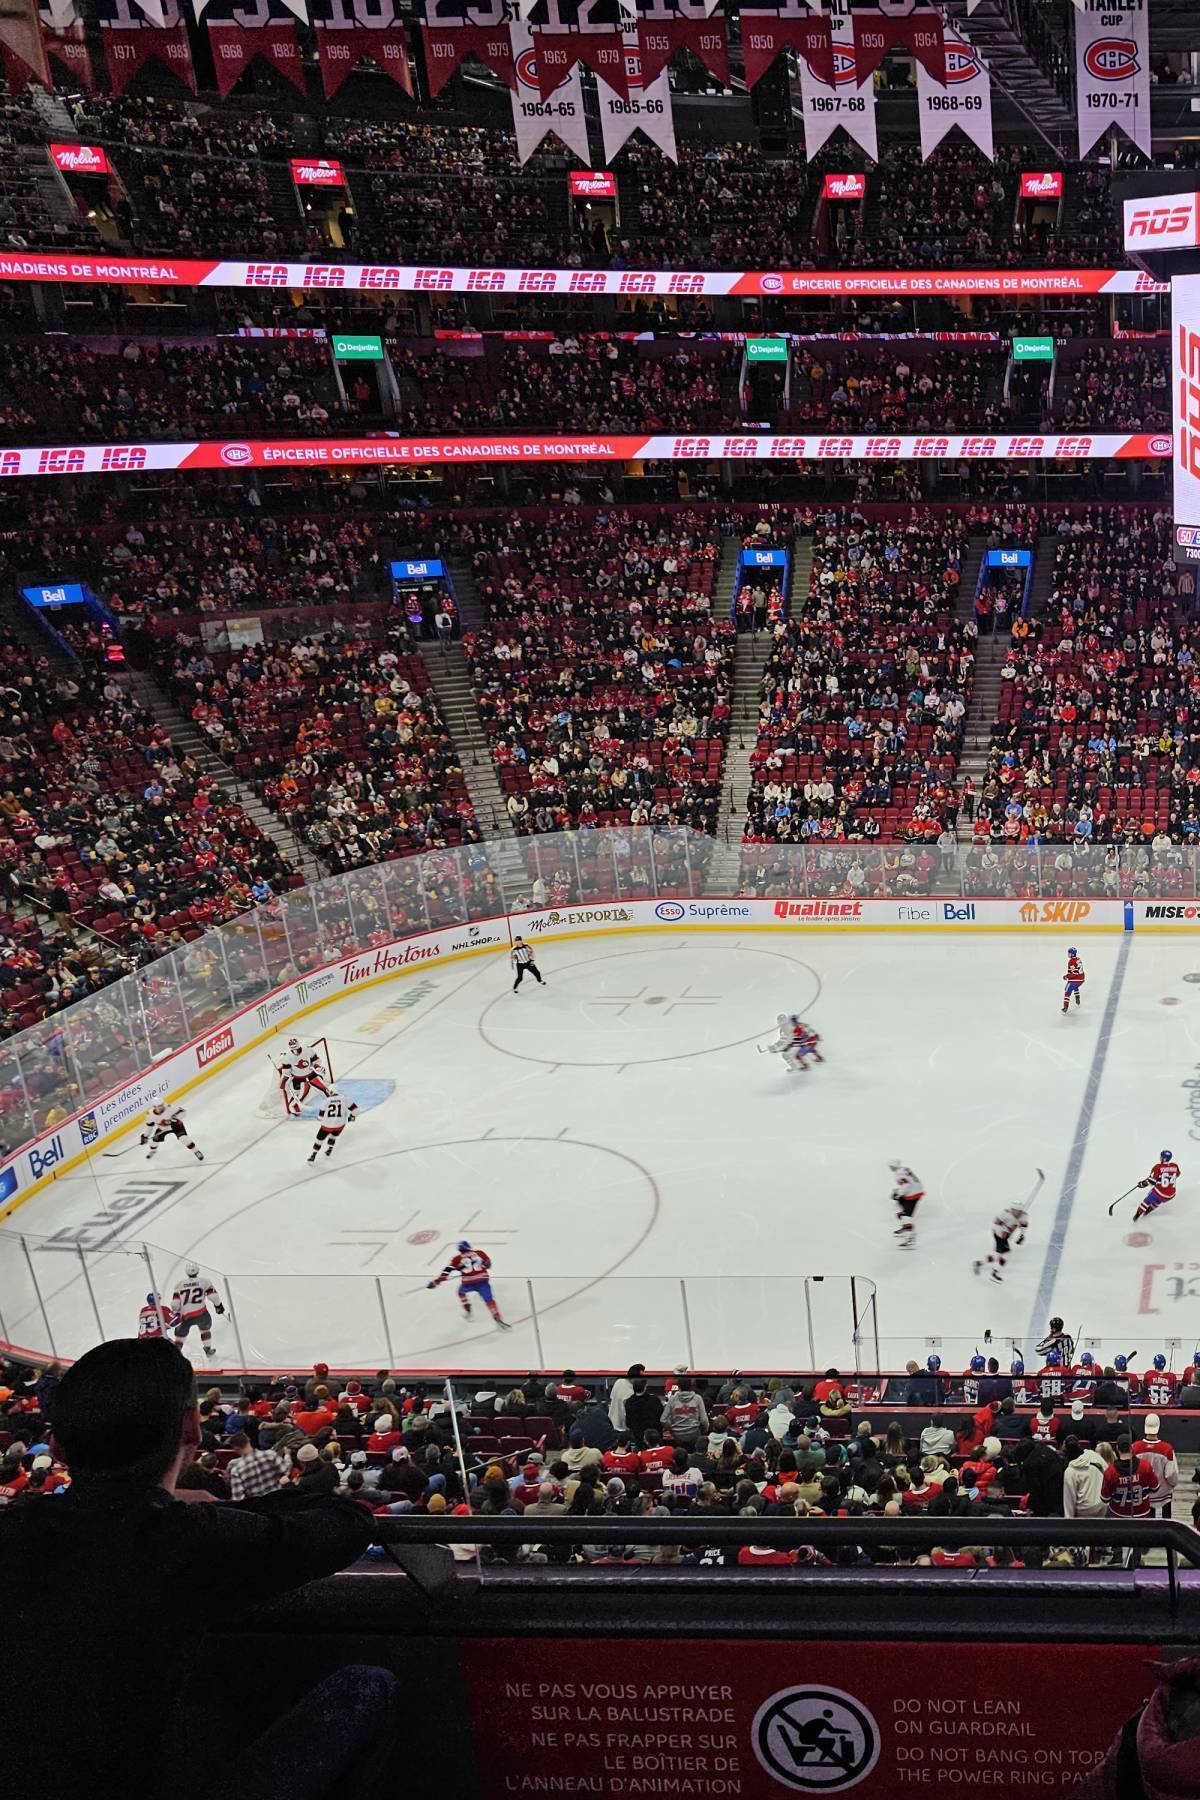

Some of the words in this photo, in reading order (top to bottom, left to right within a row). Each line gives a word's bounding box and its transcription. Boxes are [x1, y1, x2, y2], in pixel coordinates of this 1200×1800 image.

[1101, 15, 1123, 26] CUP
[645, 36, 669, 50] 1955
[700, 35, 721, 49] 1975
[749, 35, 773, 49] 1950
[806, 34, 827, 48] 1971
[861, 34, 885, 48] 1950
[914, 33, 938, 47] 1964
[63, 44, 87, 58] 1989
[113, 45, 136, 59] 1971
[219, 44, 243, 58] 1968
[326, 45, 350, 59] 1966
[382, 44, 403, 58] 1981
[432, 43, 454, 57] 1970
[487, 42, 509, 56] 1979
[598, 50, 619, 63] 1979
[543, 50, 567, 64] 1963
[608, 99, 663, 114] 1965-66
[811, 97, 865, 112] 1967-68
[926, 95, 982, 110] 1968-69
[1086, 93, 1139, 108] 1970-71
[520, 102, 575, 117] 1964-65
[57, 151, 101, 166] Molson
[1129, 206, 1192, 237] RDS
[71, 264, 92, 277] DE
[96, 264, 178, 279] MONTRÉAL
[792, 275, 842, 290] ÉPICERIE
[845, 277, 907, 290] OFFICIELLE
[910, 278, 933, 289] DES
[935, 277, 998, 289] CANADIENS
[1021, 275, 1083, 288] MONTRÉAL
[347, 343, 378, 352] Desjardins
[263, 446, 327, 461] ÉPICERIE
[331, 446, 409, 460] OFFICIELLE
[407, 564, 427, 575] Bell
[568, 908, 622, 925] EXPORT
[689, 904, 749, 918] Suprême
[774, 901, 863, 918] Qualinet
[898, 906, 930, 920] Fibe
[944, 903, 976, 920] Bell
[1041, 902, 1090, 922] SKIP
[340, 959, 370, 985] Tim
[374, 944, 441, 973] Hortons
[199, 1034, 231, 1063] Voisin
[100, 1101, 117, 1116] Les
[118, 1082, 143, 1108] idées
[103, 1100, 143, 1132] prennent
[144, 1090, 157, 1104] vie
[158, 1080, 170, 1095] ici
[327, 1103, 341, 1118] 21
[84, 1130, 98, 1145] RBC
[28, 1135, 64, 1177] Bell
[1160, 1172, 1177, 1188] 64
[180, 1288, 204, 1305] 72
[1151, 1386, 1169, 1405] 56
[705, 1549, 720, 1557] PRICE
[506, 1683, 533, 1697] NE
[539, 1684, 576, 1698] PAS
[581, 1684, 638, 1699] VOUS
[643, 1685, 733, 1700] APPUYER
[531, 1706, 570, 1720] SUR
[577, 1707, 600, 1720] LA
[607, 1708, 735, 1723] BALUSTRADE
[893, 1699, 921, 1713] DO
[928, 1699, 966, 1714] NOT
[973, 1700, 1021, 1715] LEAN
[894, 1720, 922, 1734] ON
[929, 1720, 1036, 1737] GUARDRAIL
[532, 1733, 558, 1746] NE
[564, 1733, 600, 1747] PAS
[607, 1734, 692, 1749] FRAPPER
[699, 1735, 737, 1749] SUR
[604, 1756, 626, 1770] LE
[632, 1752, 708, 1771] BOÎTIER
[714, 1757, 740, 1771] DE
[896, 1747, 924, 1761] DO
[931, 1748, 968, 1762] NOT
[976, 1749, 1027, 1764] BANG
[1034, 1750, 1062, 1764] ON
[1069, 1750, 1104, 1765] TOP
[896, 1768, 931, 1782] THE
[938, 1769, 1004, 1784] POWER
[1011, 1771, 1054, 1785] RING
[506, 1776, 602, 1792] L'ANNEAU
[610, 1777, 742, 1793] D'ANIMATION
